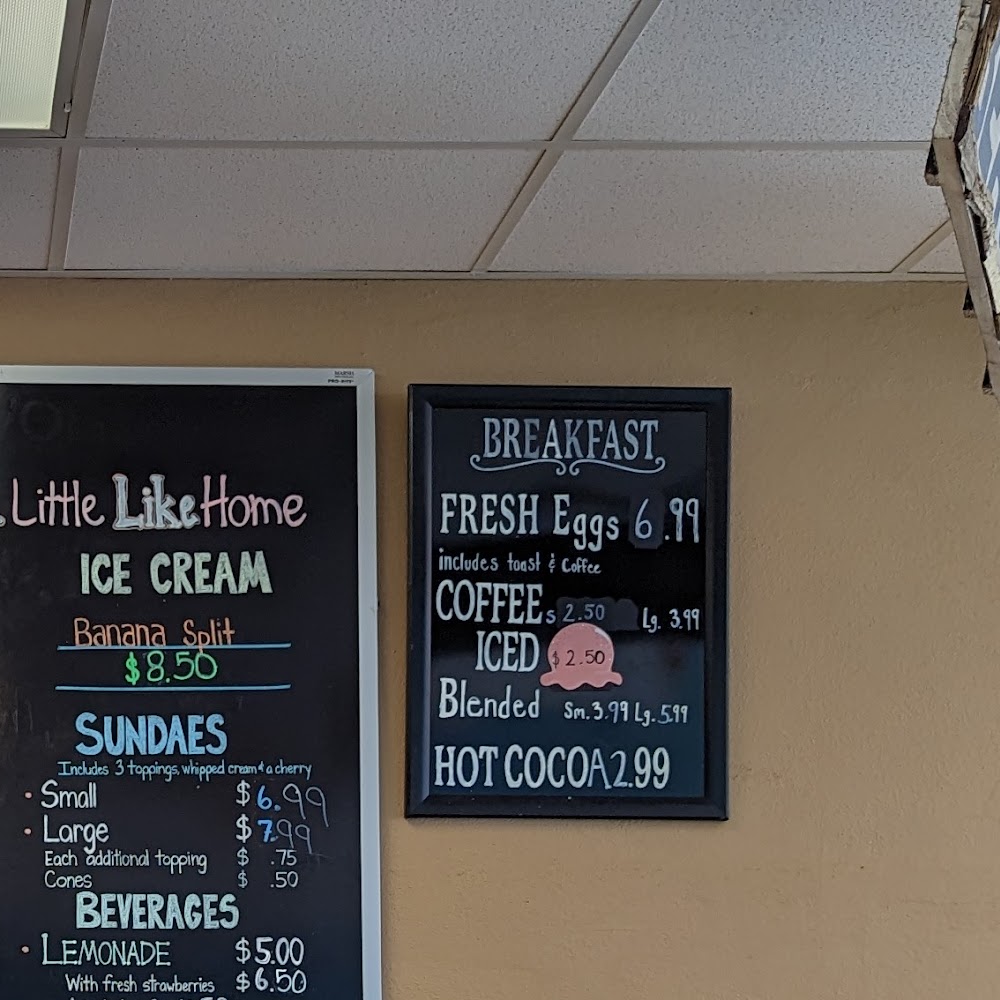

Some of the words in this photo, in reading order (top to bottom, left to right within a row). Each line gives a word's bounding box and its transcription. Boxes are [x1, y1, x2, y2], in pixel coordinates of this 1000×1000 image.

[482, 417, 659, 461] BREAKFAST
[11, 477, 105, 527] Little
[112, 473, 200, 531] Like
[200, 474, 307, 528] Home
[439, 492, 539, 536] FRESH
[552, 494, 620, 552] Eggs
[80, 552, 133, 595] ICE
[149, 550, 274, 595] CREAM
[438, 548, 499, 572] includes
[507, 552, 540, 573] toast
[435, 579, 544, 625] COFFEE
[73, 616, 167, 648] Banana
[182, 616, 236, 654] Split
[475, 630, 540, 673] ICED
[125, 650, 219, 686] $8.50
[438, 676, 540, 719] Blended
[75, 711, 229, 756] SUNDAES
[57, 760, 109, 776] Includes
[182, 761, 226, 782] whipped
[275, 763, 313, 781] cherry
[434, 745, 499, 788] HOT
[504, 744, 612, 790] COCOA
[610, 746, 670, 790] 2.99
[40, 779, 98, 809] Small
[43, 814, 110, 854] Large
[44, 871, 93, 889] Cones
[45, 850, 78, 867] Each
[85, 849, 149, 868] additional
[154, 852, 208, 874] topping
[75, 891, 240, 930] BEVERAGES
[41, 932, 172, 967] LEMONADE
[235, 936, 305, 966] $5.00
[64, 973, 98, 993] With
[102, 973, 138, 992] fresh
[142, 974, 216, 993] strawberries
[235, 967, 307, 994] $6.50
